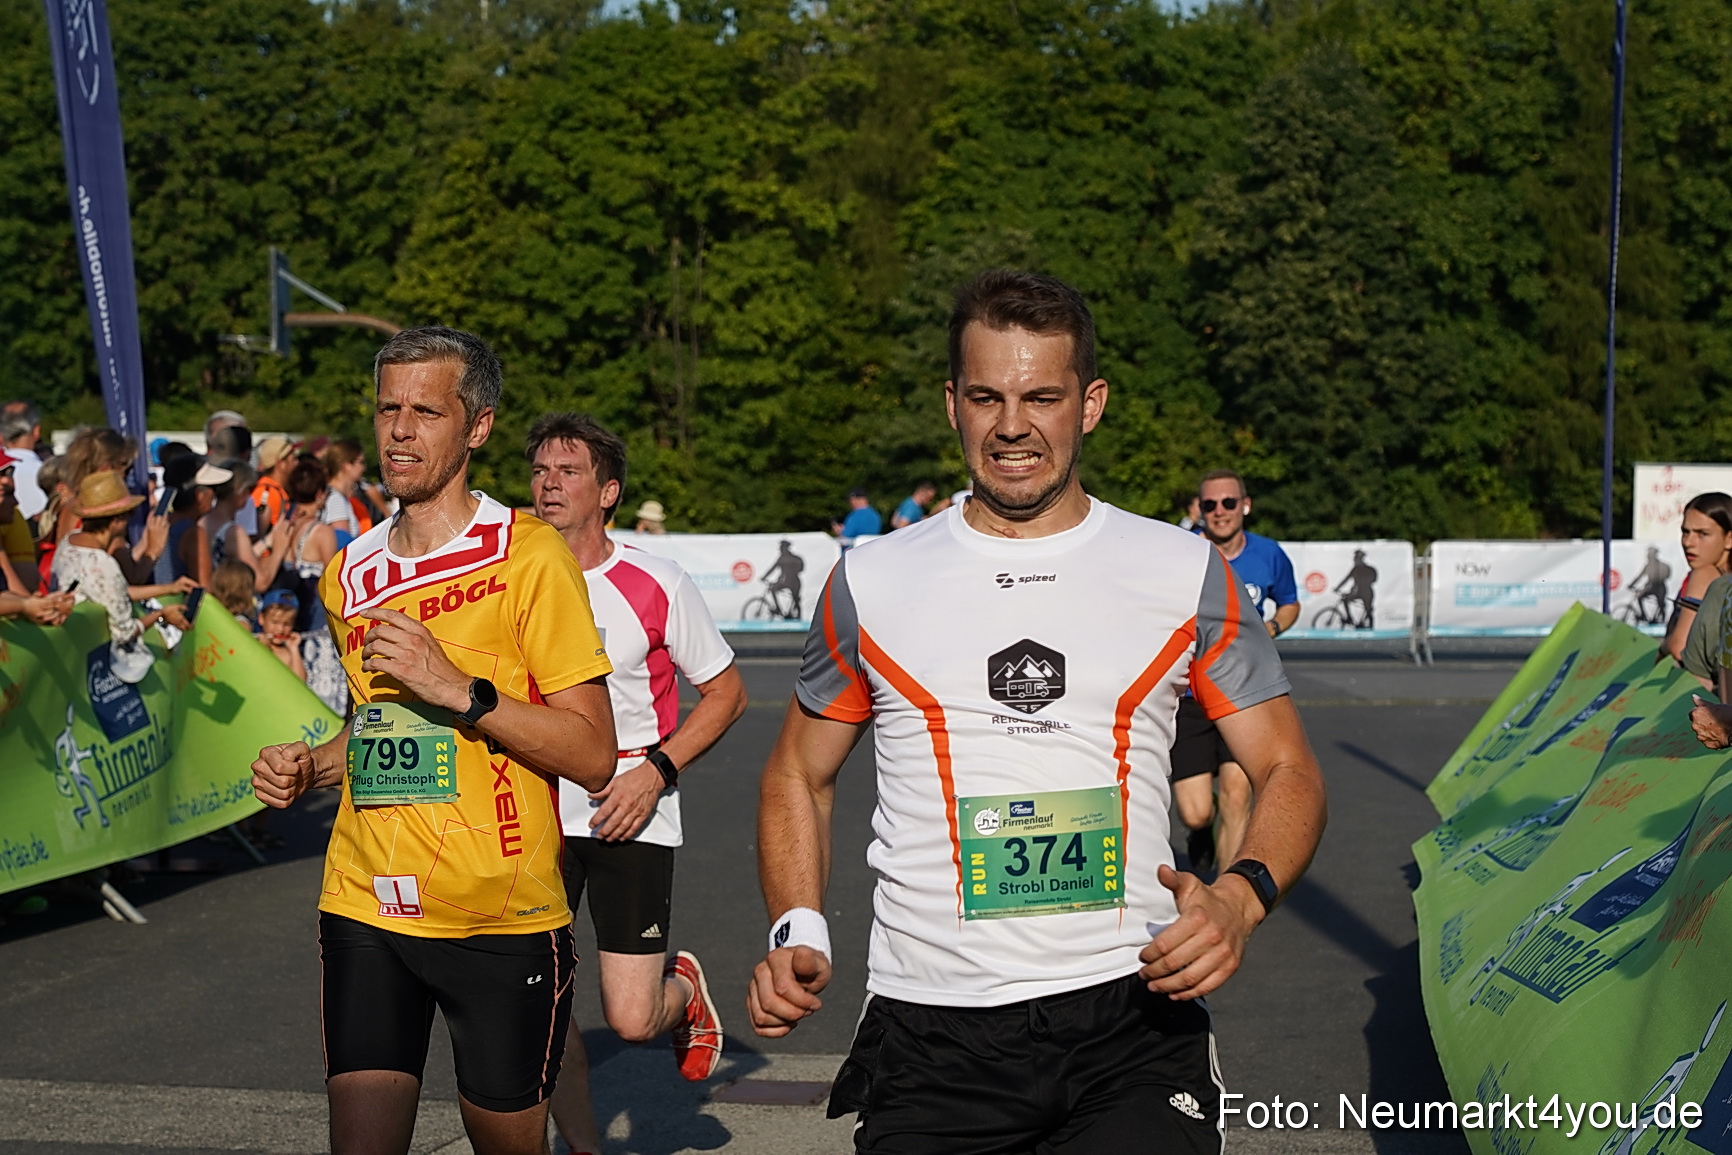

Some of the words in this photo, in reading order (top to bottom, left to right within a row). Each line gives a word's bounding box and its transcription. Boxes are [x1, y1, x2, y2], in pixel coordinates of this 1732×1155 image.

[1018, 574, 1056, 583] spized
[419, 574, 506, 622] BÖGL
[1007, 726, 1056, 735] STROBL
[361, 738, 420, 771] 799
[436, 742, 450, 788] 2022
[352, 775, 374, 788] Pflug
[376, 773, 436, 787] Christoph
[1002, 813, 1054, 828] Firmenlauf
[1023, 822, 1054, 831] neumarkt
[1003, 832, 1088, 877] 374
[1103, 836, 1118, 892] 2022
[971, 853, 987, 895] RUN
[999, 880, 1045, 895] Strobl
[1050, 875, 1094, 892] Daniel
[1169, 1096, 1206, 1120] adidas
